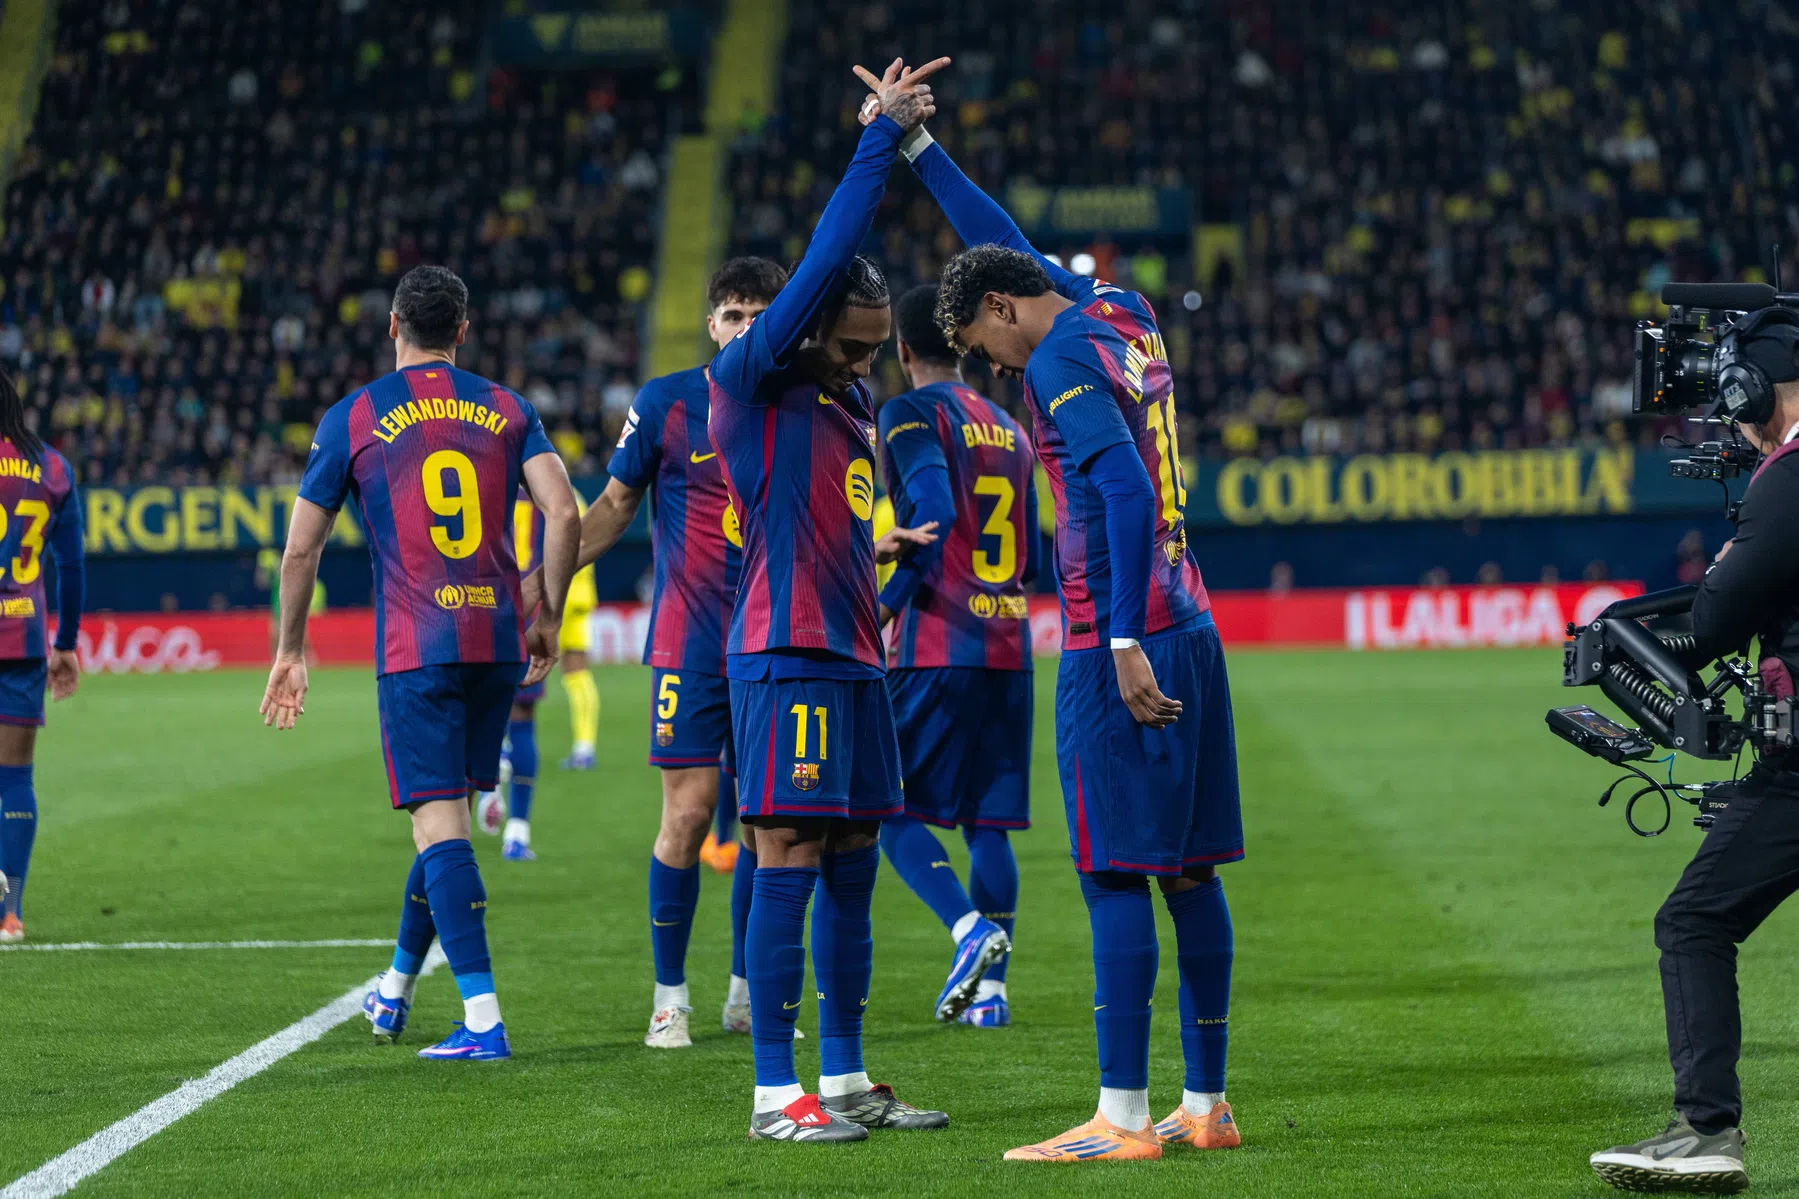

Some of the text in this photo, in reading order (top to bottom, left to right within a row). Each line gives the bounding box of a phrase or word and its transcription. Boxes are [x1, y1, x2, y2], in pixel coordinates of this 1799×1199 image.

[372, 398, 508, 444] LEWANDOWSKI
[961, 422, 1016, 452] BALDE
[422, 450, 482, 559] 9
[1218, 449, 1633, 526] COLOROBBIA
[0, 498, 50, 585] 3
[972, 475, 1016, 583] 3
[657, 673, 681, 720] 5
[790, 703, 828, 760] 11
